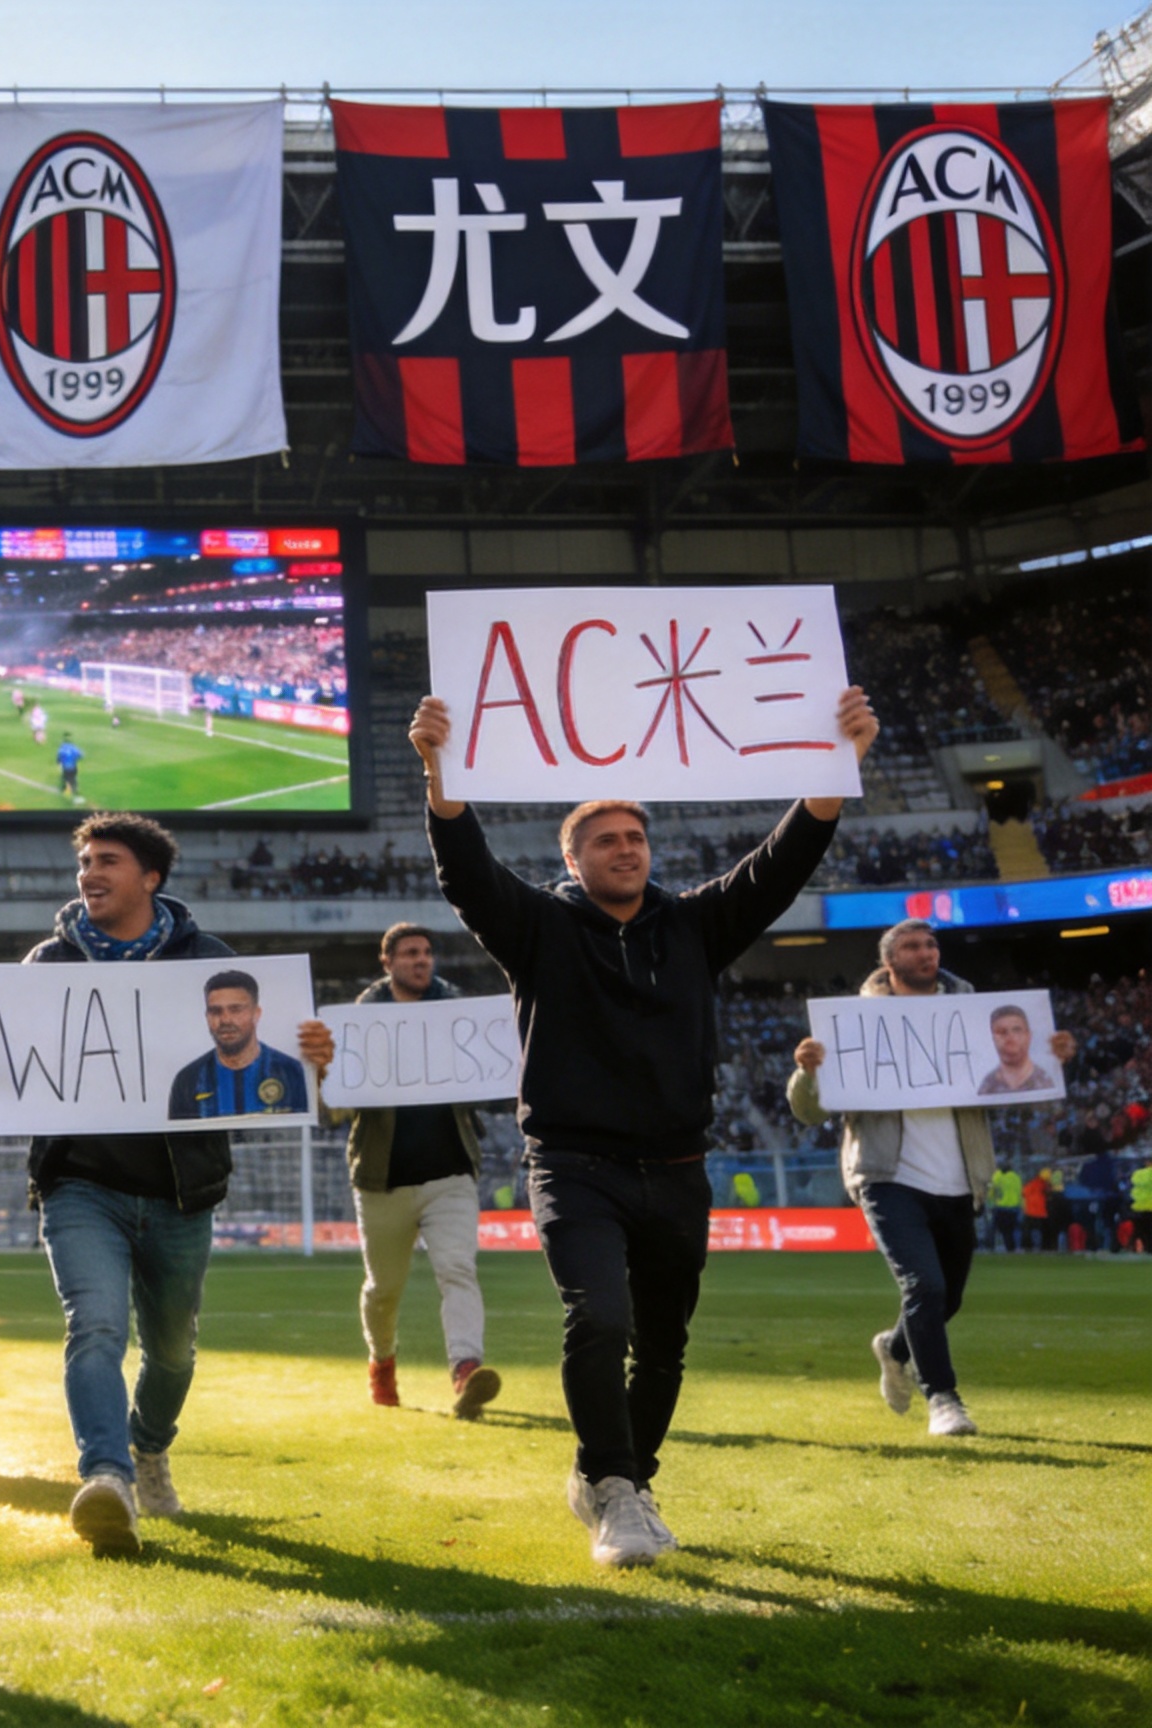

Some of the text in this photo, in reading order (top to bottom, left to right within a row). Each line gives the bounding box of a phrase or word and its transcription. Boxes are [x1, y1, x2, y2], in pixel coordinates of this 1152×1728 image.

[30, 158, 131, 213] ACM
[391, 177, 691, 344] 尤文
[45, 367, 124, 401] 1999
[923, 379, 1010, 415] 1999
[832, 1010, 976, 1090] HANA
